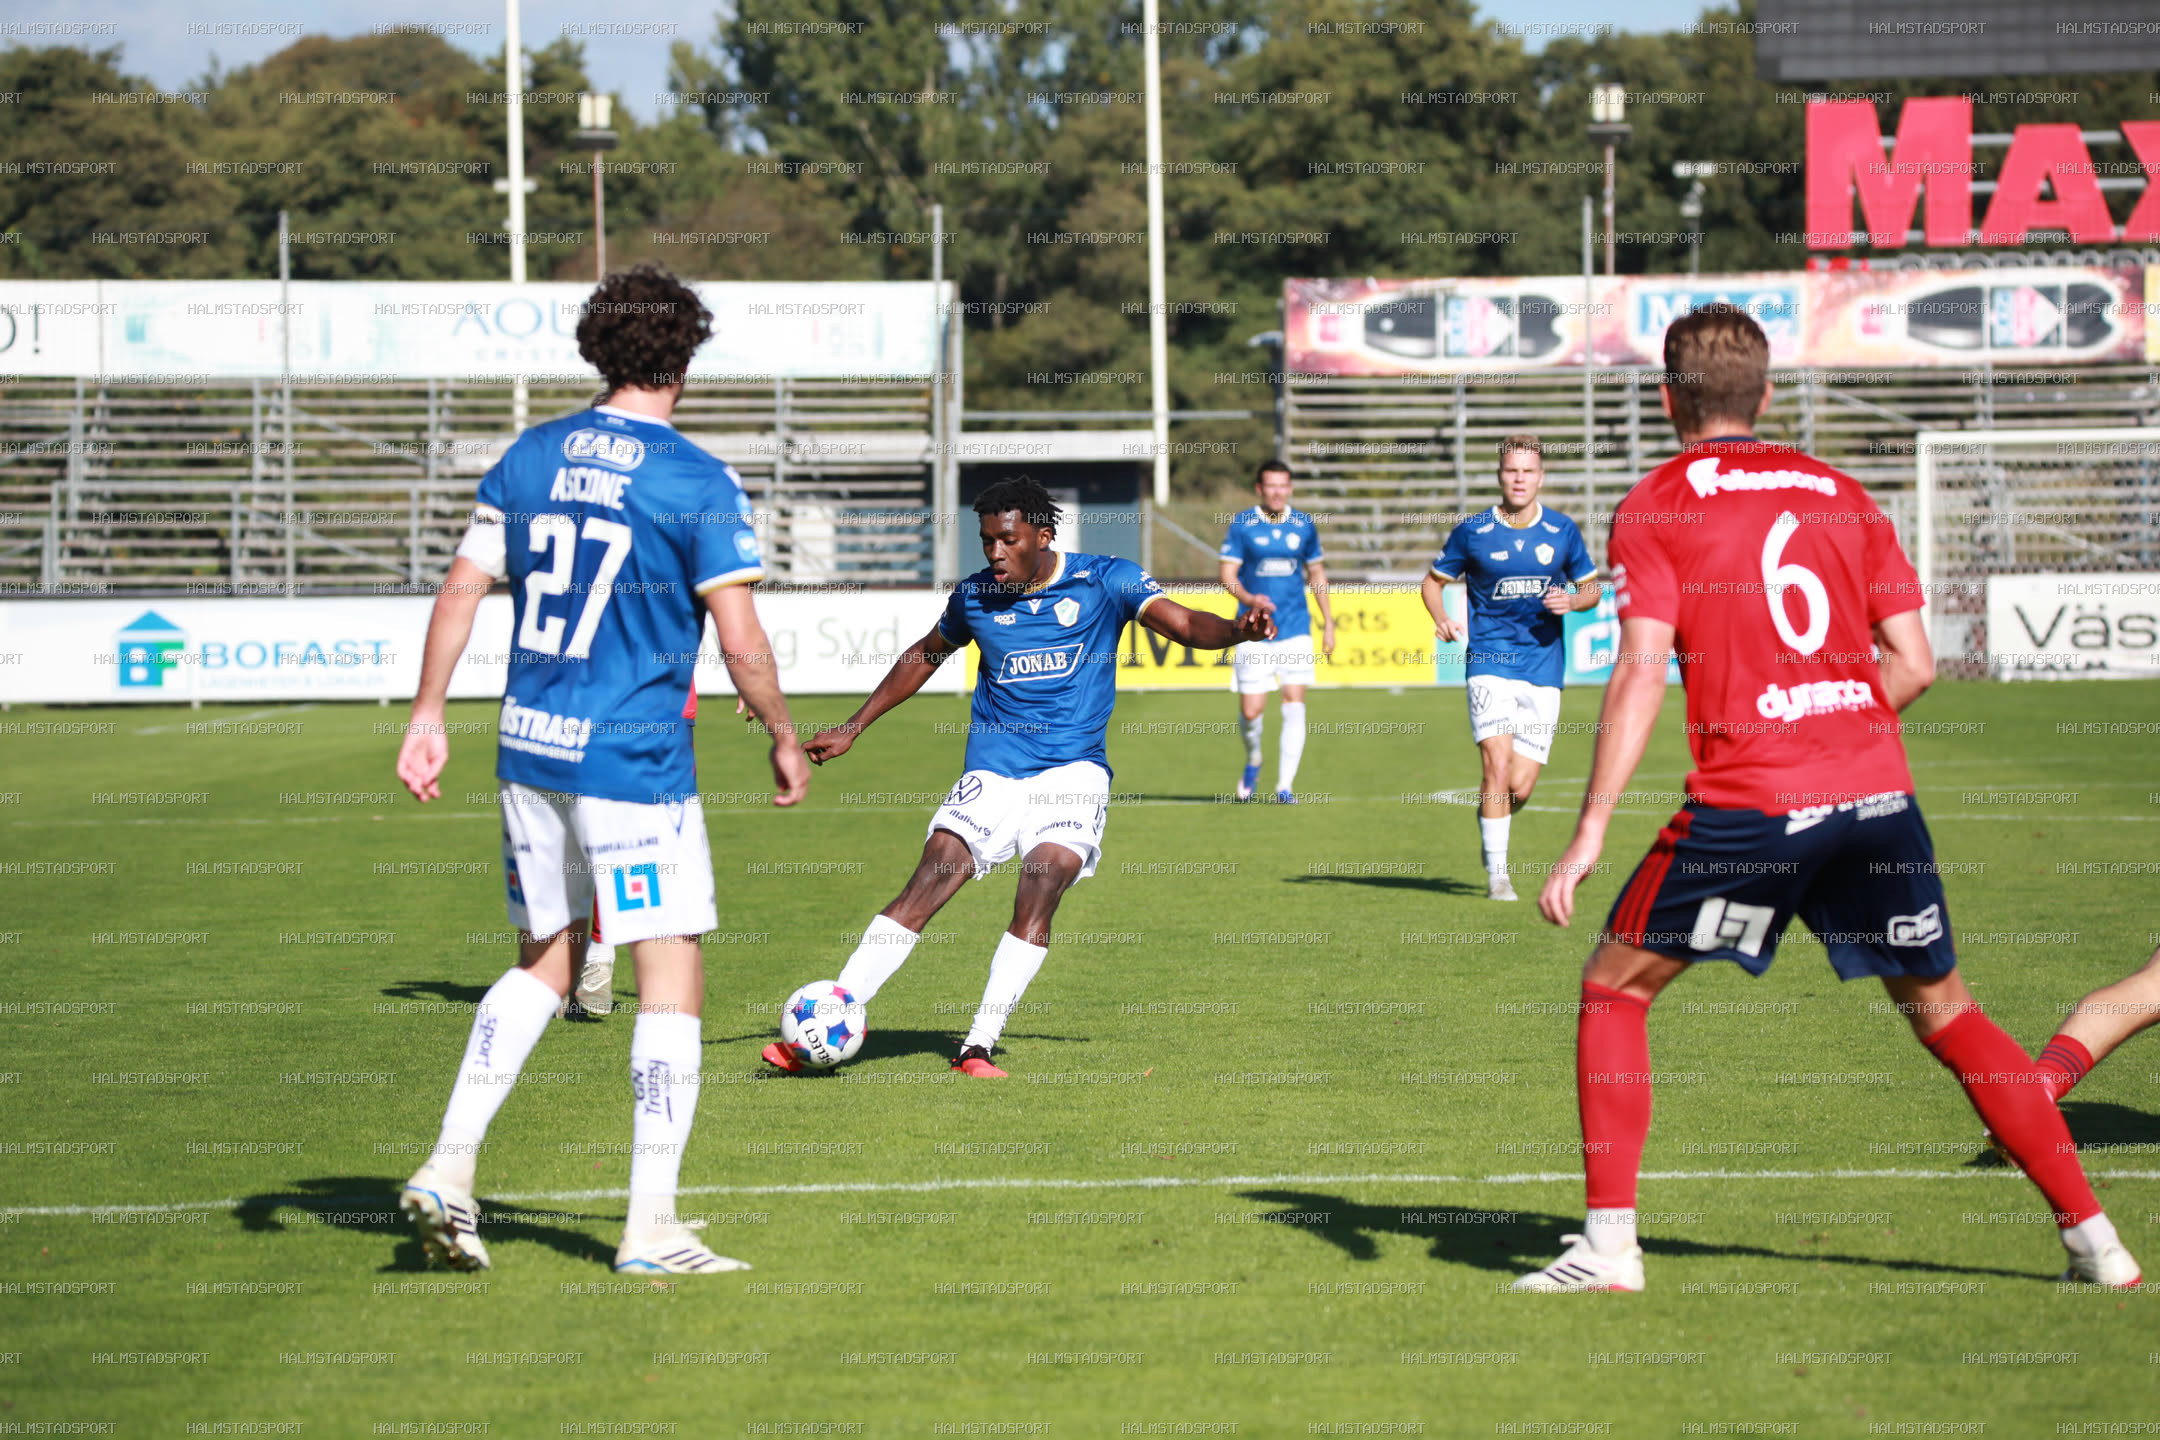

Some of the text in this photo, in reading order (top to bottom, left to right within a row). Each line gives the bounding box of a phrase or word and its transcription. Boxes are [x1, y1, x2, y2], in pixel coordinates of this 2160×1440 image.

[550, 467, 632, 511] ASCONE
[518, 513, 632, 659] 27
[1761, 511, 1830, 656] 6
[2014, 603, 2157, 650] Väs
[201, 640, 391, 669] BOFAST
[1009, 651, 1067, 676] JONAB
[804, 1028, 834, 1065] SELECT
